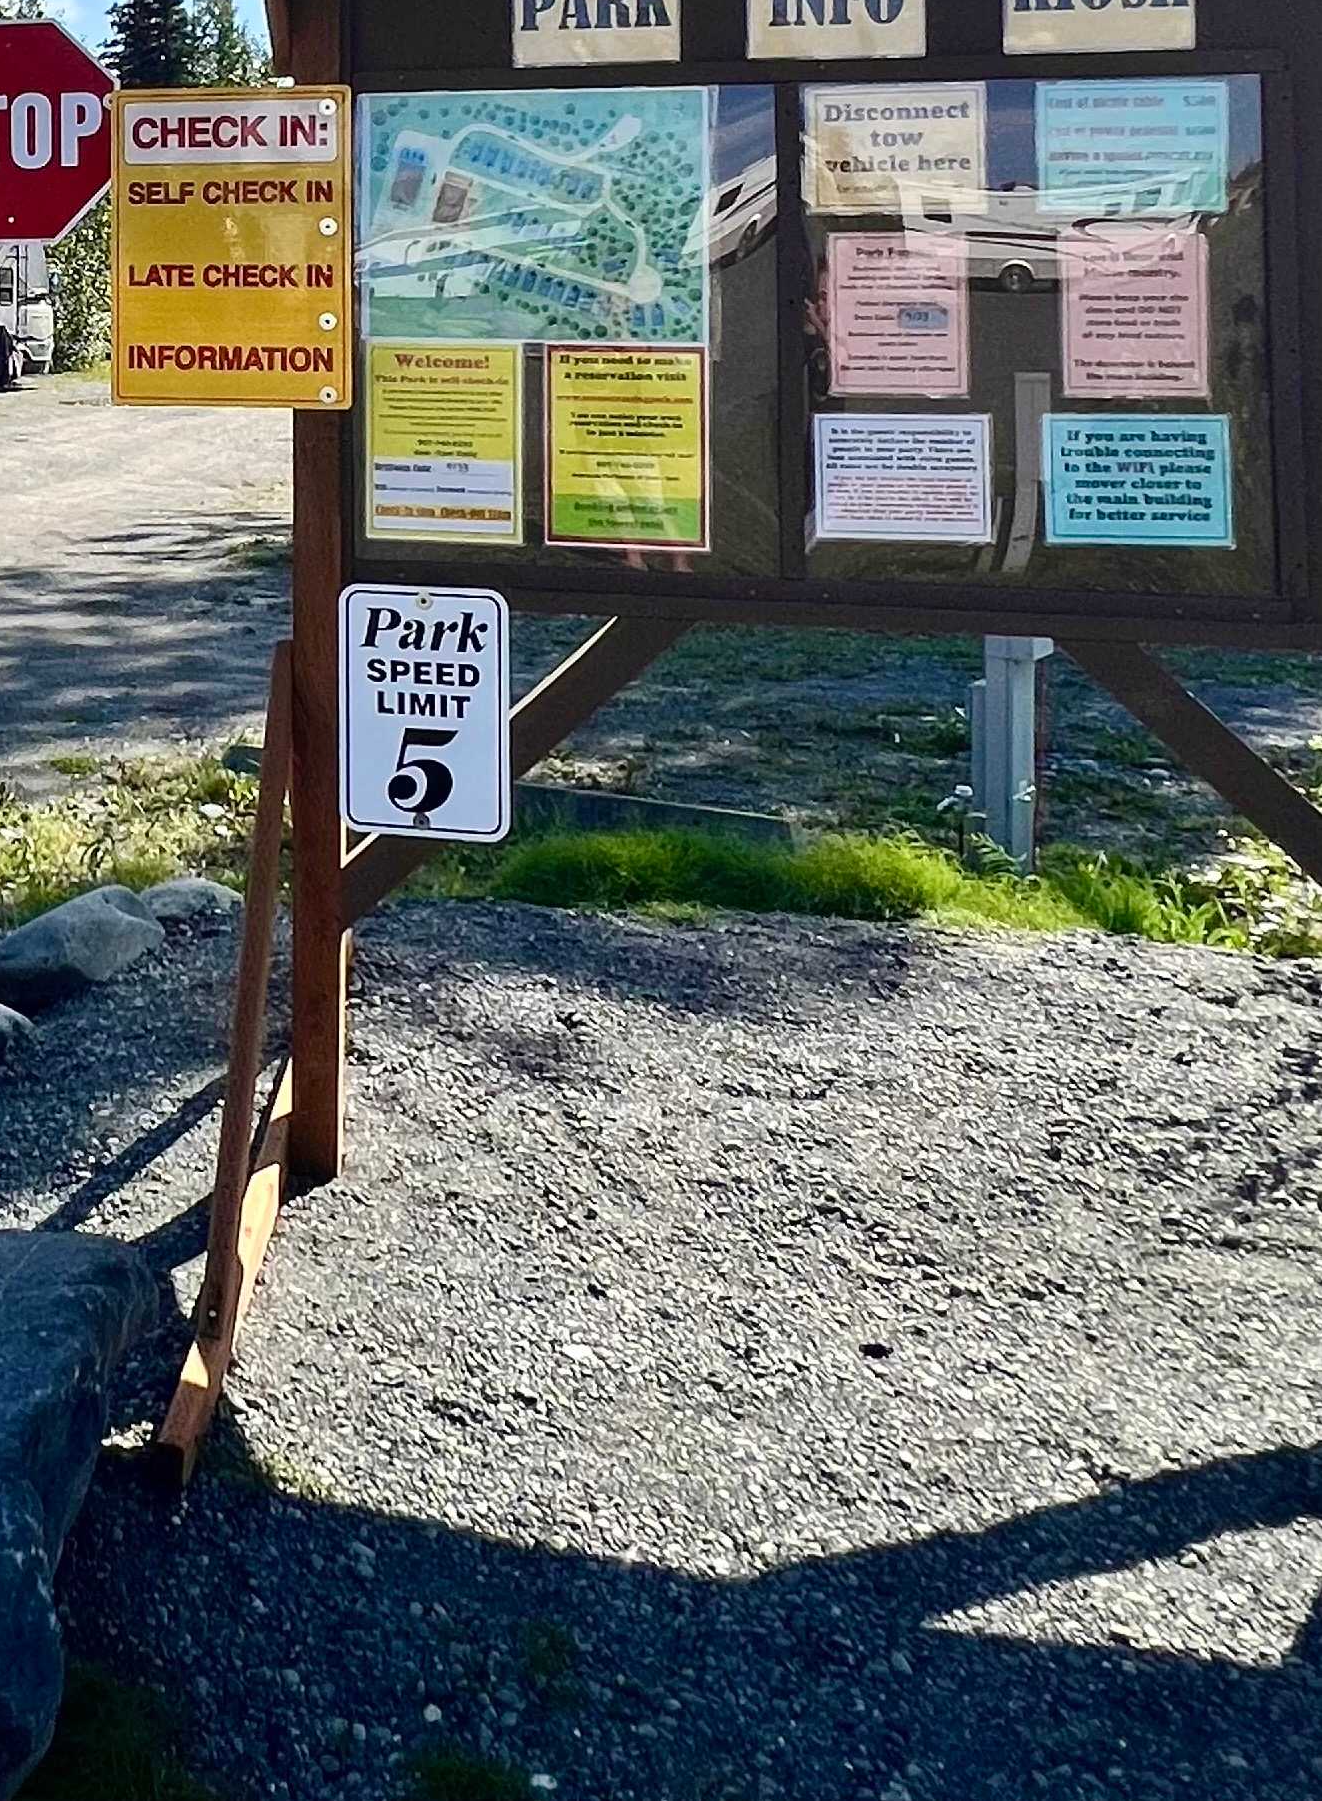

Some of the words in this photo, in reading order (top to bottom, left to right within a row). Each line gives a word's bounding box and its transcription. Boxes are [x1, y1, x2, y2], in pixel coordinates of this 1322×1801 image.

[823, 102, 970, 122] Disconnect
[132, 115, 268, 149] CHECK
[279, 114, 328, 147] IN:
[870, 129, 924, 147] tow
[825, 154, 910, 173] vehicle
[918, 154, 971, 171] here
[128, 181, 195, 205] SELF
[202, 180, 299, 205] CHECK
[306, 180, 333, 203] IN
[128, 264, 195, 287] LATE
[202, 264, 299, 288] CHECK
[306, 264, 333, 288] IN
[128, 345, 334, 372] INFORMATION
[394, 353, 490, 369] Welcome!
[574, 356, 598, 366] you
[602, 355, 634, 365] need
[637, 355, 651, 365] to
[575, 371, 653, 381] reservation
[656, 372, 686, 381] visit
[1067, 430, 1081, 441] If
[1085, 432, 1114, 444] you
[1118, 432, 1146, 442] are
[1150, 430, 1207, 445] having
[1061, 446, 1119, 457] trouble
[1124, 446, 1215, 460] connecting
[1064, 462, 1080, 473] to
[1085, 462, 1112, 473] the
[1159, 462, 1212, 476] please
[1075, 479, 1126, 489] mover
[1131, 477, 1181, 489] closer
[1185, 478, 1202, 490] to
[1066, 493, 1093, 505] the
[1097, 494, 1139, 505] main
[1142, 493, 1213, 508] building
[1069, 508, 1092, 520] for
[1096, 508, 1146, 521] better
[1150, 510, 1210, 521] service
[359, 607, 489, 653] Park
[366, 658, 481, 687] SPEED
[377, 691, 471, 719] LIMIT
[387, 727, 459, 813] 5
